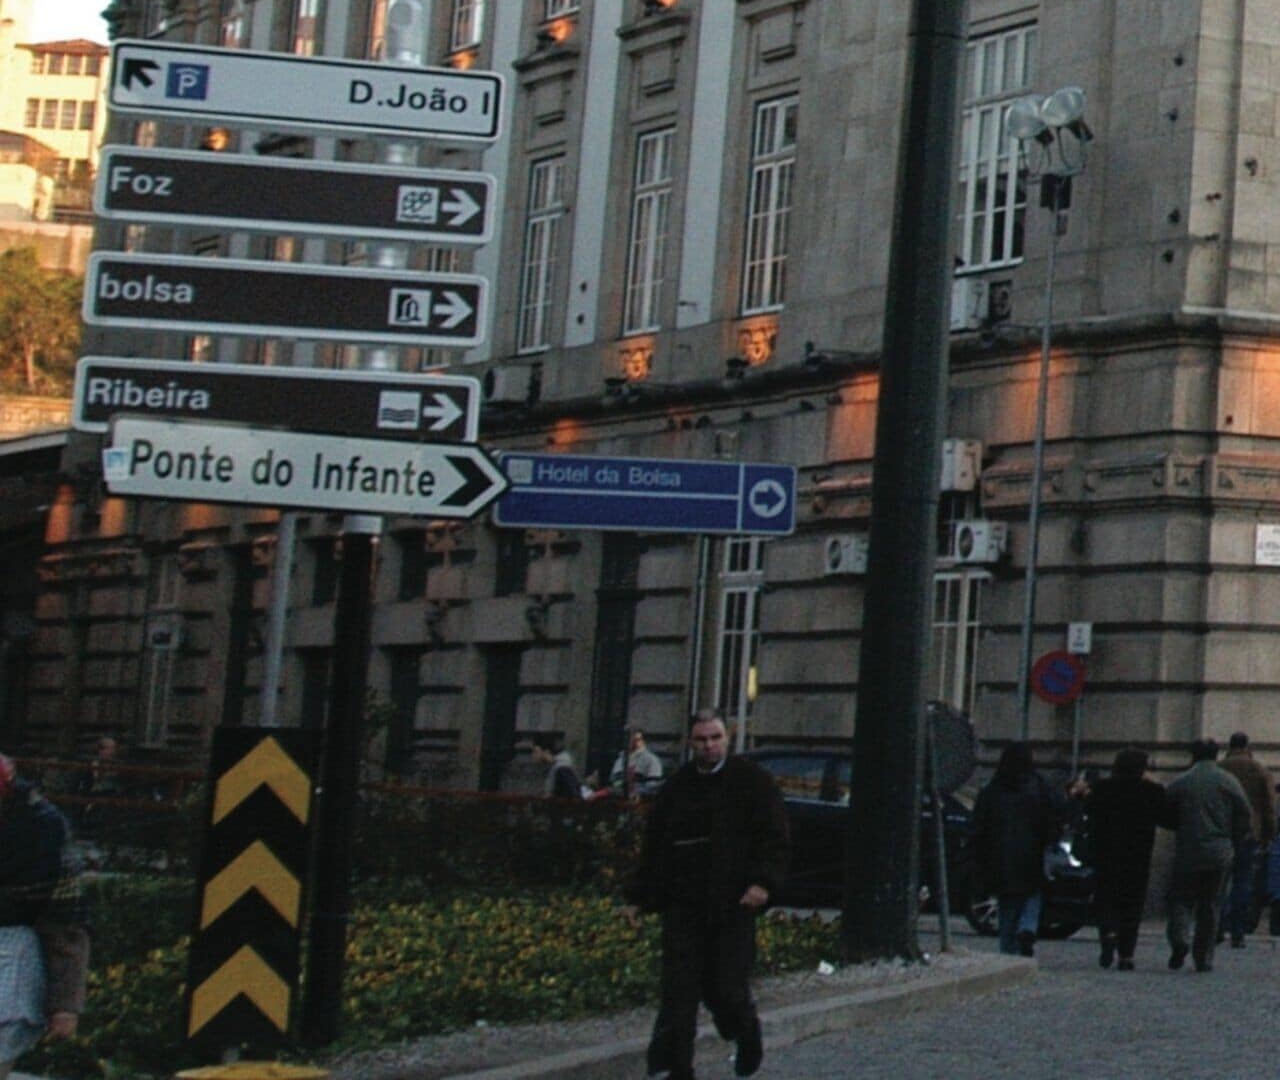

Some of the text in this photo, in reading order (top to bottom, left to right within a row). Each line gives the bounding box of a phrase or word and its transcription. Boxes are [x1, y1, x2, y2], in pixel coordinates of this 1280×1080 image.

[348, 78, 468, 115] D.João
[110, 165, 174, 197] Foz
[99, 272, 195, 305] bolsa
[87, 376, 211, 410] Ribeira
[128, 438, 437, 497] Ponte do Infante
[537, 463, 681, 487] Hotel da Bolsa
